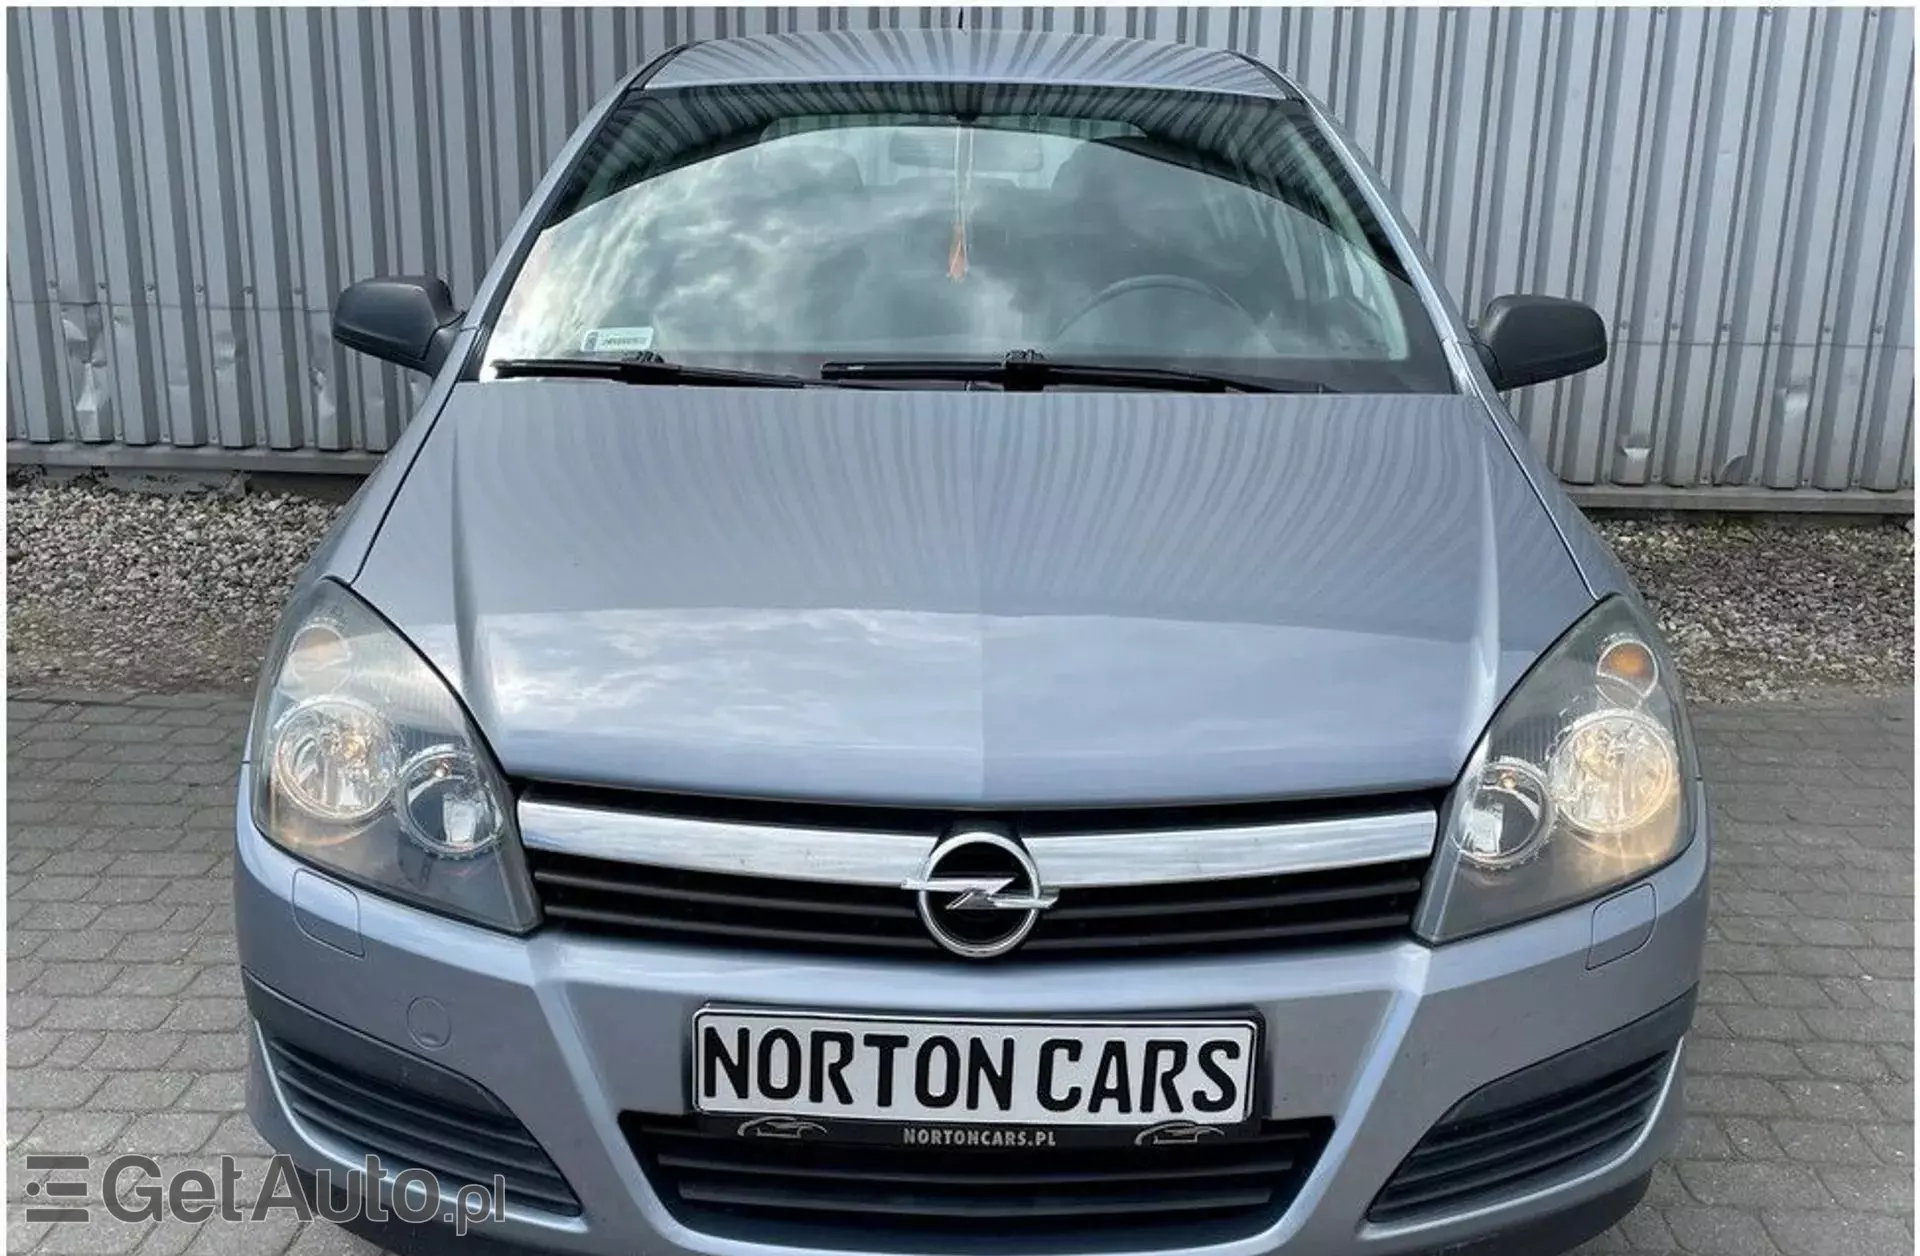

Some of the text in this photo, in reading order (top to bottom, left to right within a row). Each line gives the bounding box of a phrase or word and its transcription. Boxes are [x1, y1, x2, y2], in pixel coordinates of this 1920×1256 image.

[704, 1026, 1240, 1112] NORTON CARS
[903, 1127, 1056, 1147] NORTONCARS.PL
